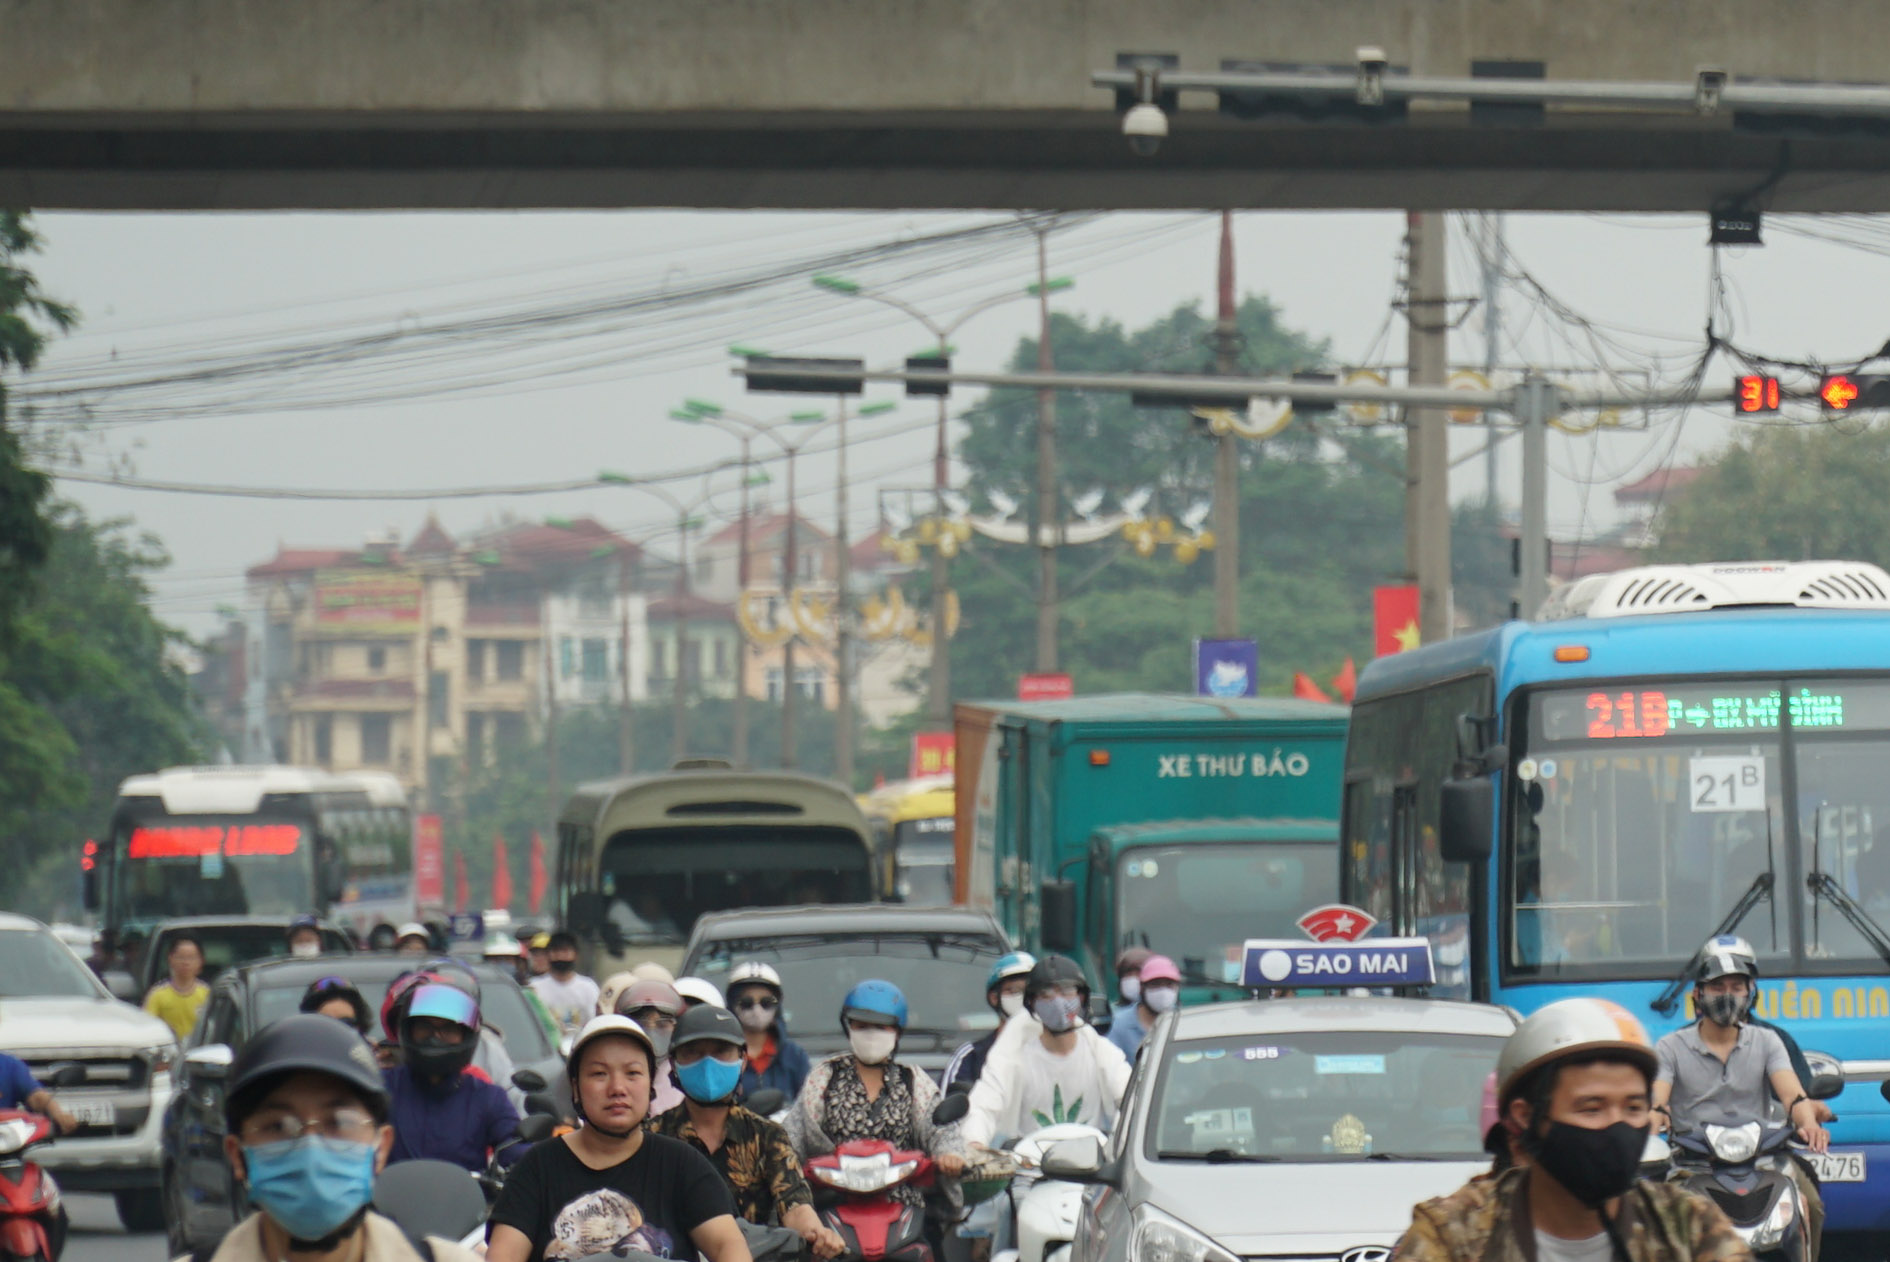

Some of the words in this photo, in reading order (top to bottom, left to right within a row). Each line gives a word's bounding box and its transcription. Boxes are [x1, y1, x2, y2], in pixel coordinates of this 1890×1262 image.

[1741, 376, 1780, 412] 31
[1158, 754, 1192, 778] XE
[1197, 752, 1246, 777] THƯ
[1251, 746, 1310, 777] BÁO
[1296, 953, 1352, 975] SAO
[1359, 953, 1408, 974] MAI
[1757, 980, 1822, 1018] LIÊN
